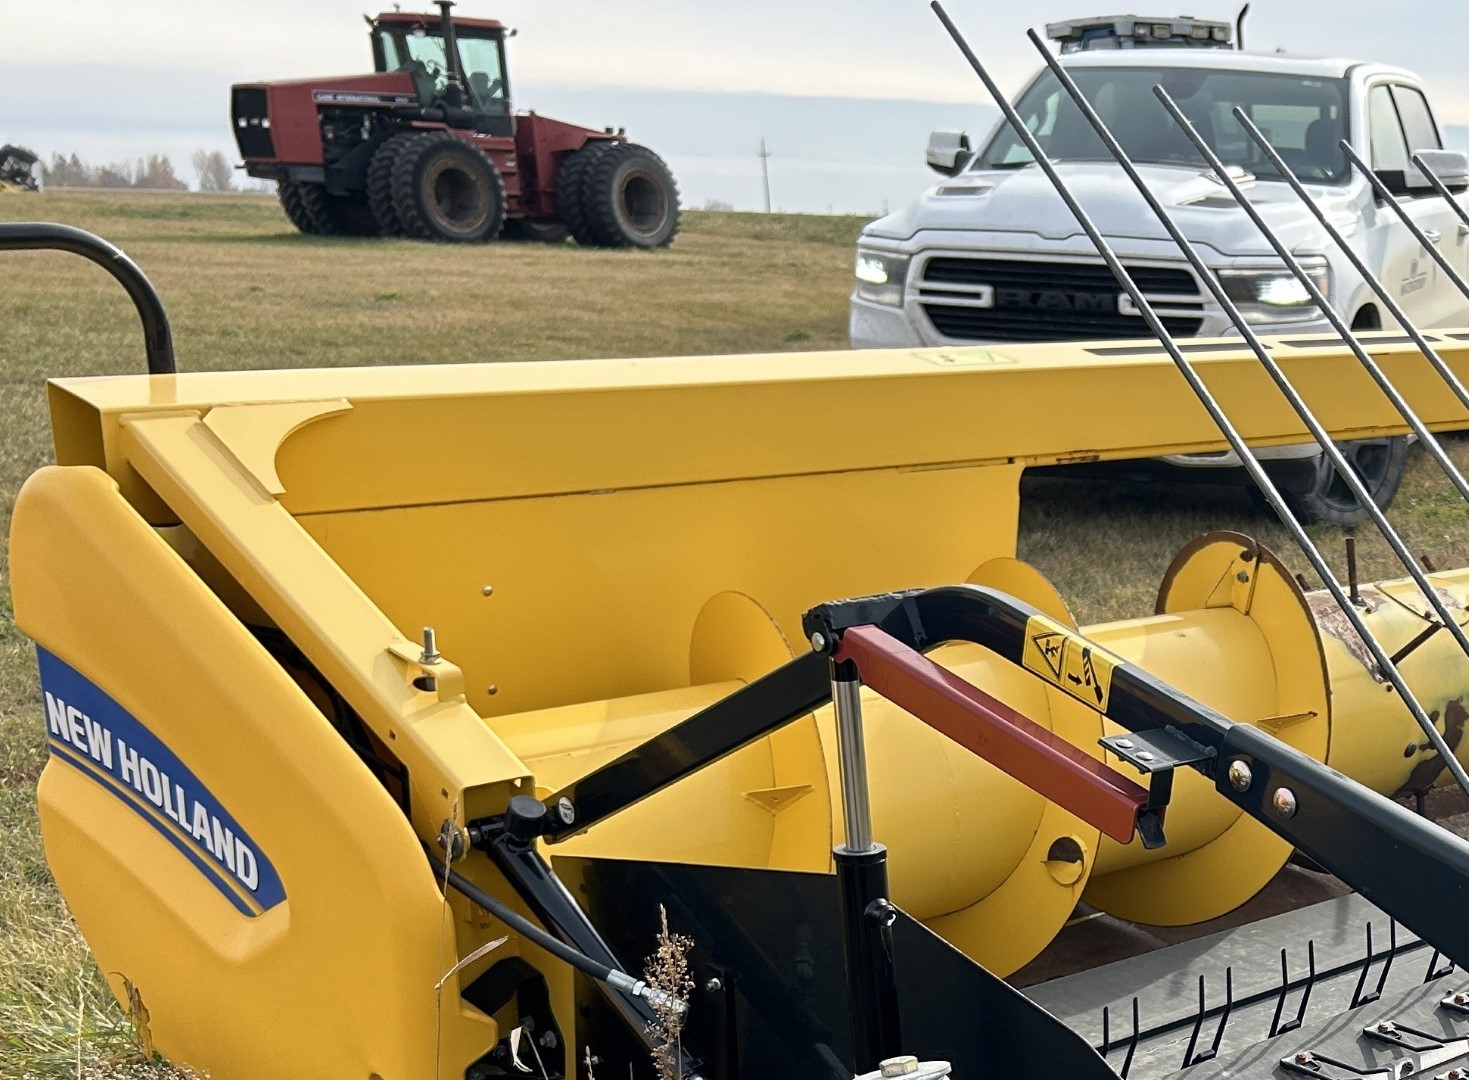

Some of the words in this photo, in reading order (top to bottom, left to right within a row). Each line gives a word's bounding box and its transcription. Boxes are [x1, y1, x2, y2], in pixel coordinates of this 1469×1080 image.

[997, 287, 1114, 312] RAM
[45, 690, 113, 771] NEW
[117, 738, 260, 892] HOLLAND
